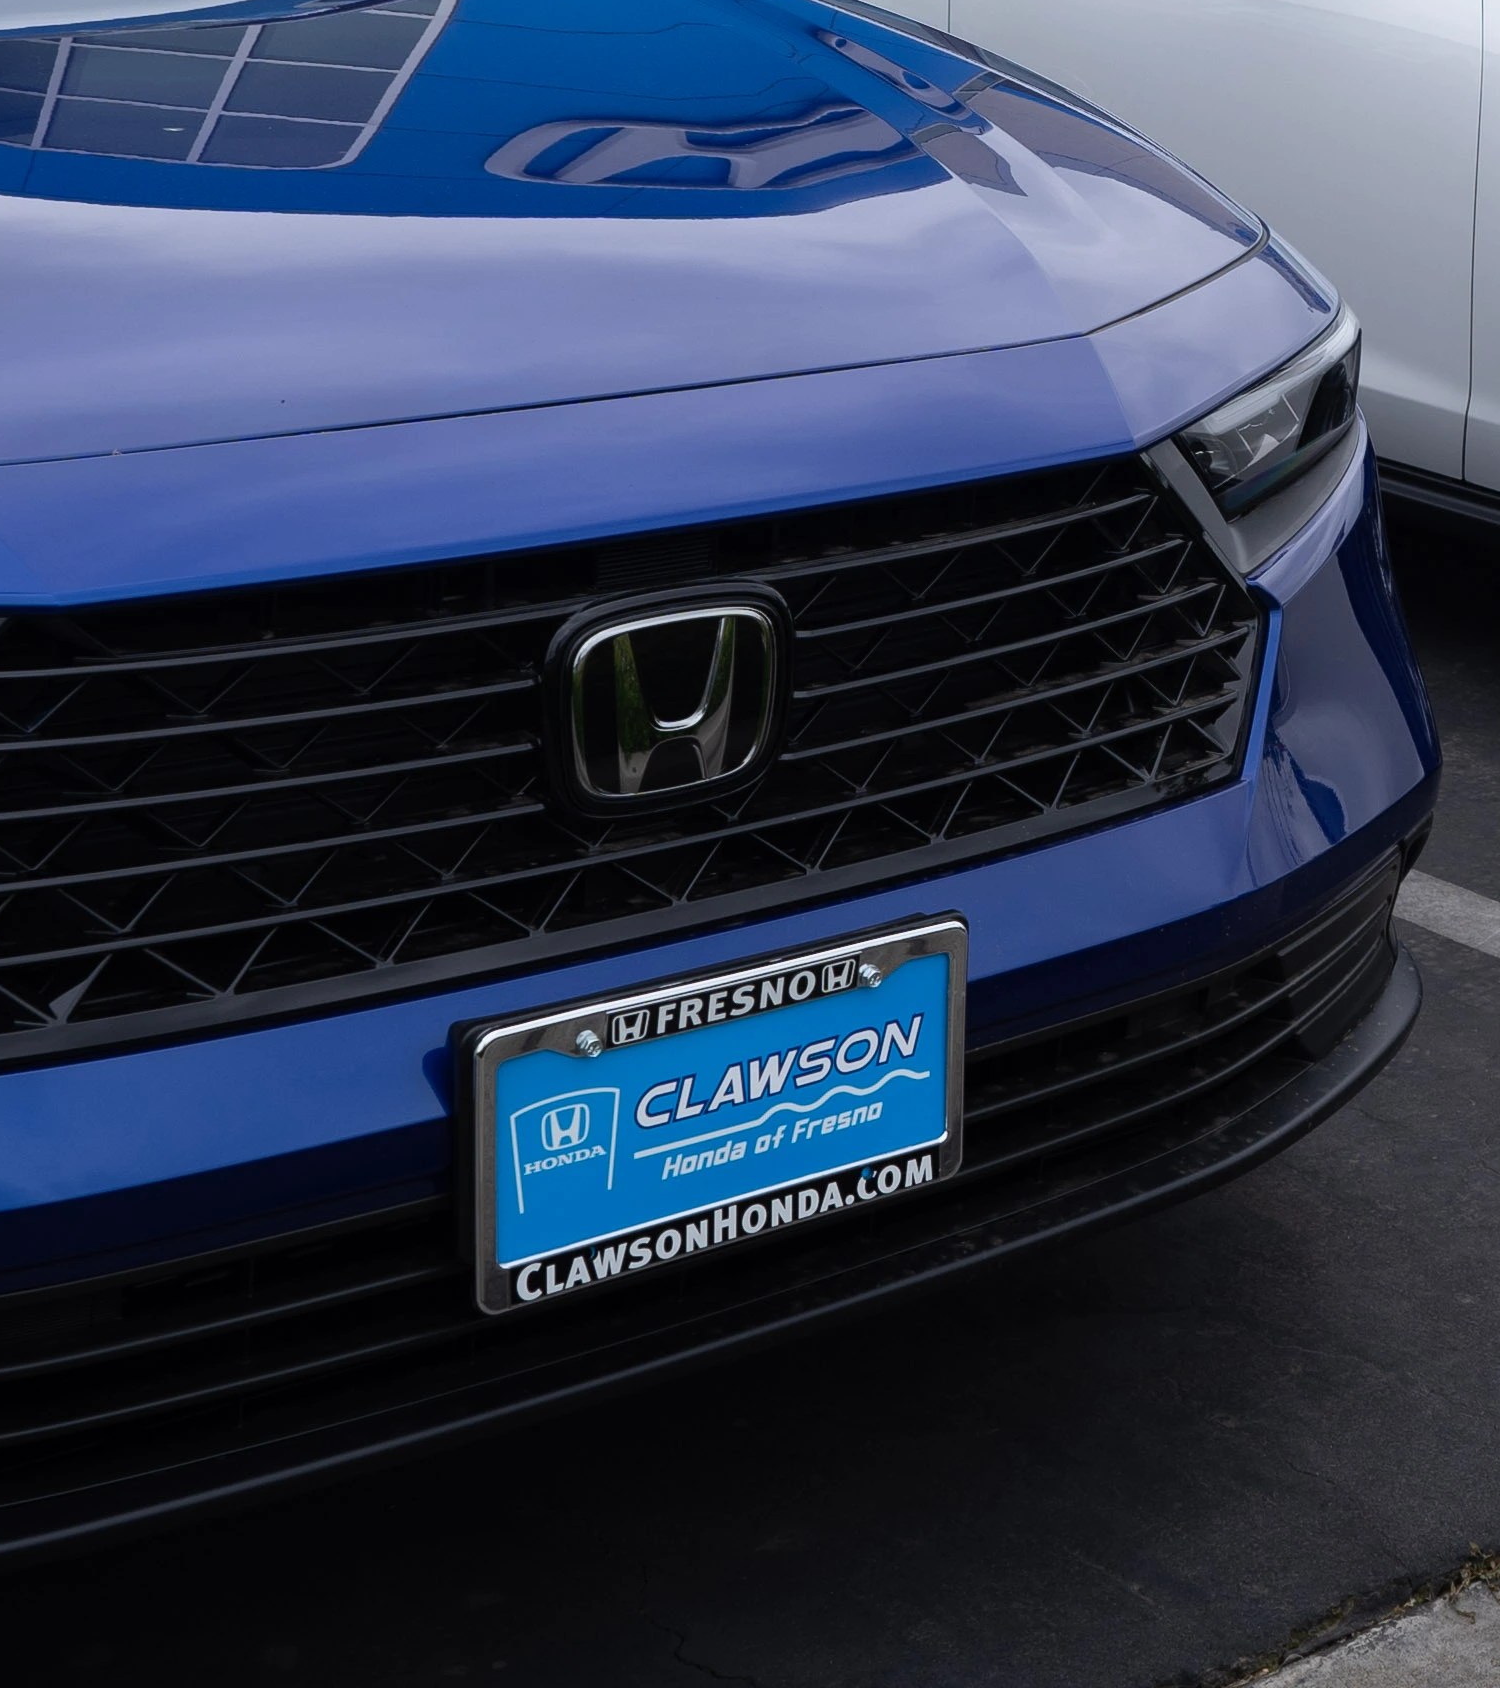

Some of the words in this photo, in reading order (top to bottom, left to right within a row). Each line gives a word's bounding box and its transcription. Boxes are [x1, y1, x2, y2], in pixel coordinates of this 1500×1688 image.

[655, 970, 817, 1035] FRESNO
[634, 1012, 925, 1130] CLAWSON
[522, 1144, 608, 1177] HONDA
[661, 1139, 748, 1181] Honda
[753, 1123, 788, 1155] of
[791, 1101, 884, 1145] Fresno
